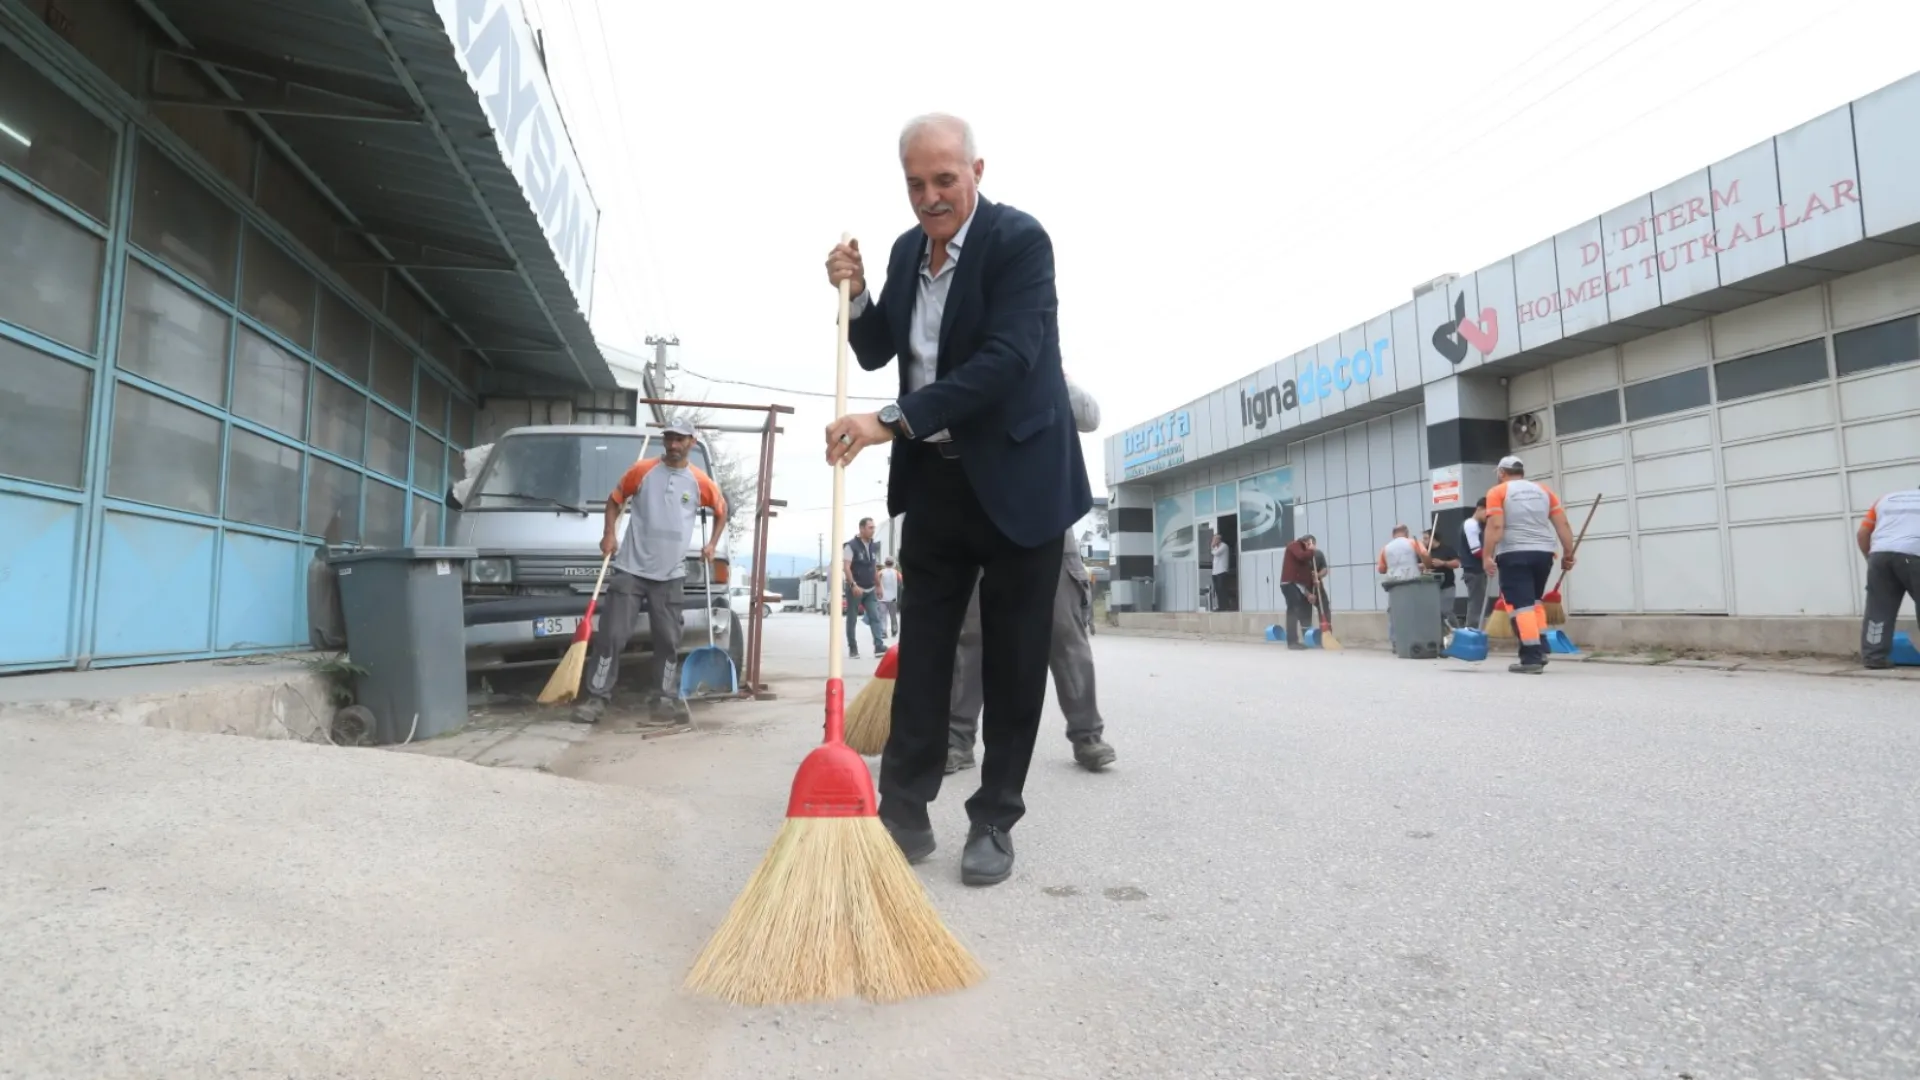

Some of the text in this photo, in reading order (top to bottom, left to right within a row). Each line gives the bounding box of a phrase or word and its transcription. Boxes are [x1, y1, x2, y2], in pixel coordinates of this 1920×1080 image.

[1518, 178, 1860, 324] HOLMELT TUTKALLAR
[1123, 410, 1190, 458] berkfa
[547, 618, 563, 633] 35
